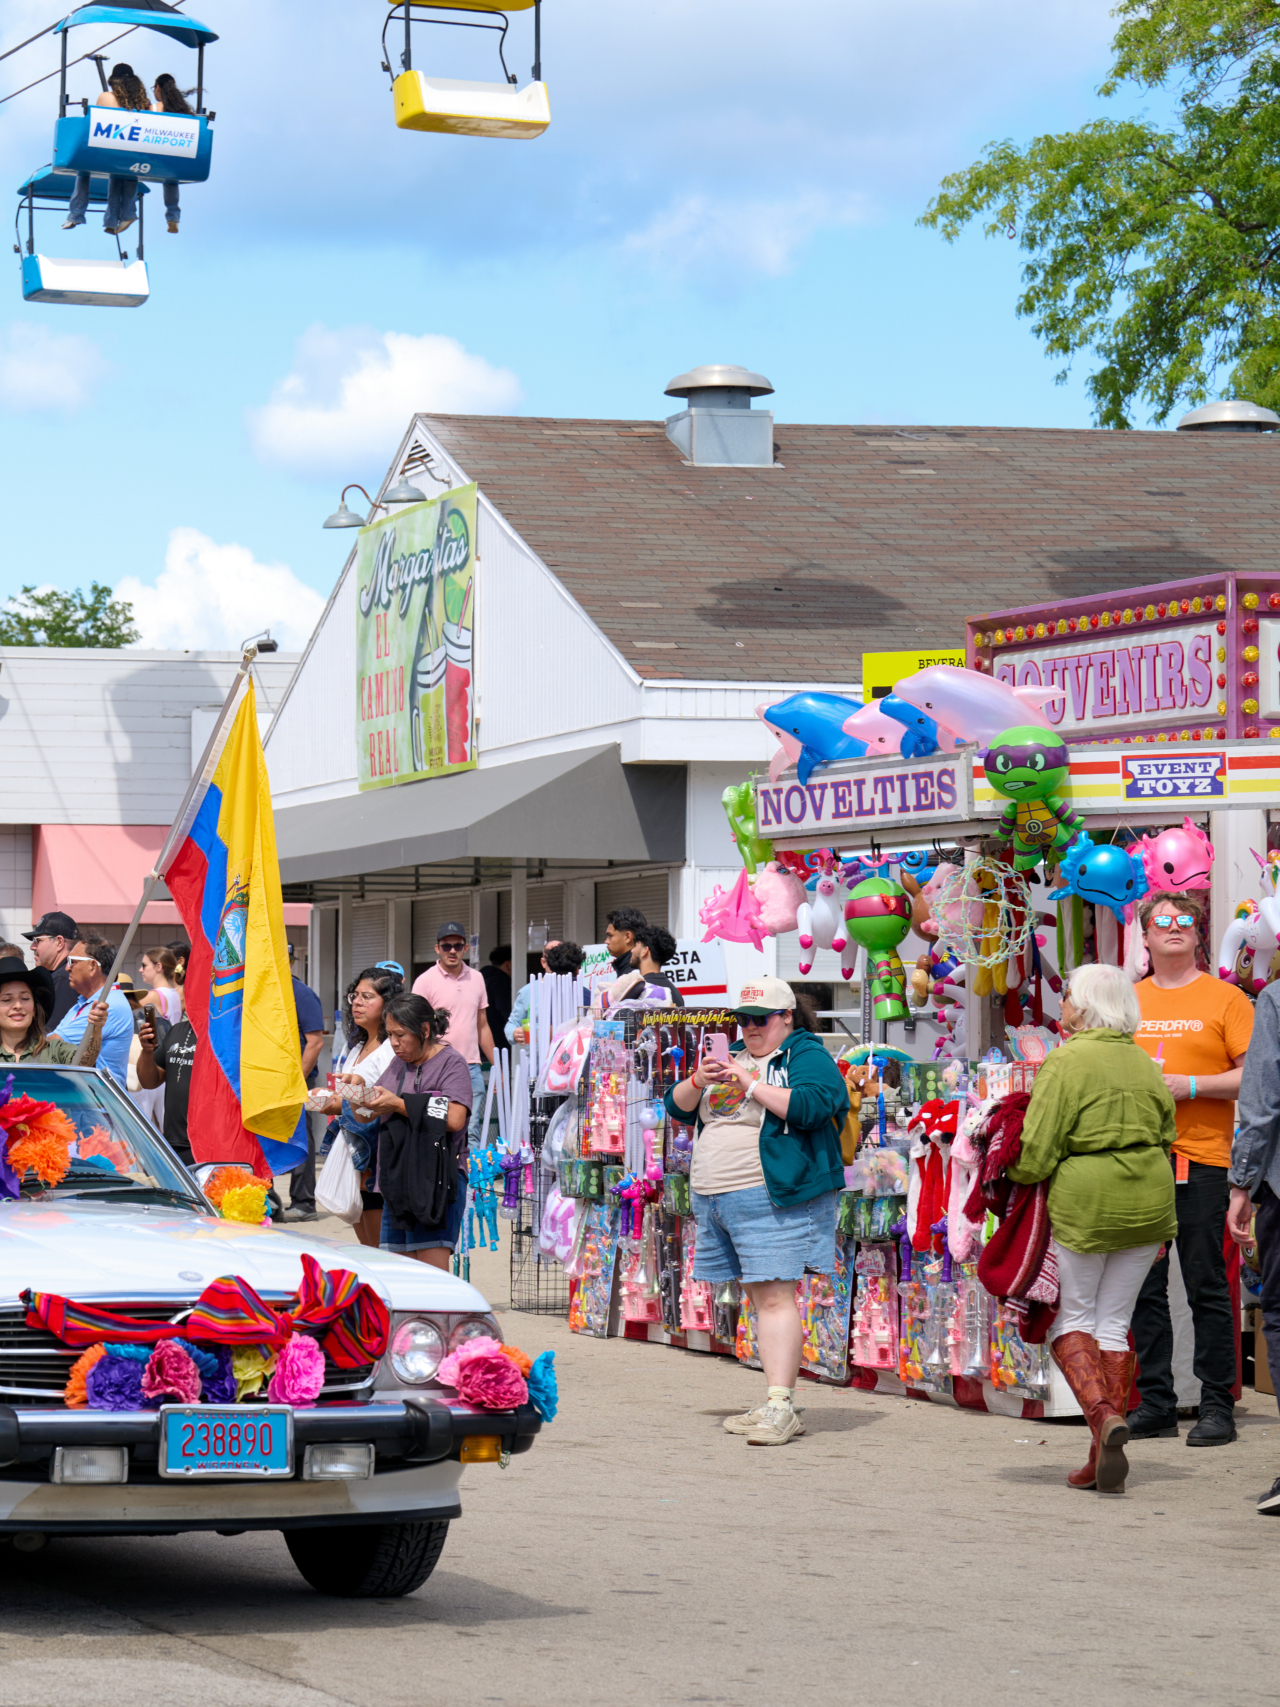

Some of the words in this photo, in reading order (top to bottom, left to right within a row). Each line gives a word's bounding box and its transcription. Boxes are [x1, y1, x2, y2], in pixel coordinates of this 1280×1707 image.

[93, 121, 142, 142] MKE
[144, 127, 196, 140] MILWAUKEE
[142, 135, 194, 149] AIRPORT
[129, 162, 151, 174] 49
[376, 612, 390, 659] EL
[918, 658, 965, 669] BEVERA
[361, 666, 405, 721] CAMINO
[369, 728, 399, 778] REAL
[1137, 762, 1212, 775] EVENT
[1137, 778, 1212, 794] TOYZ
[760, 768, 957, 826] NOVELTIES
[1029, 822, 1039, 832] D
[664, 968, 697, 982] REA
[182, 1423, 273, 1457] 238890
[196, 1461, 260, 1469] WISCONSIN
